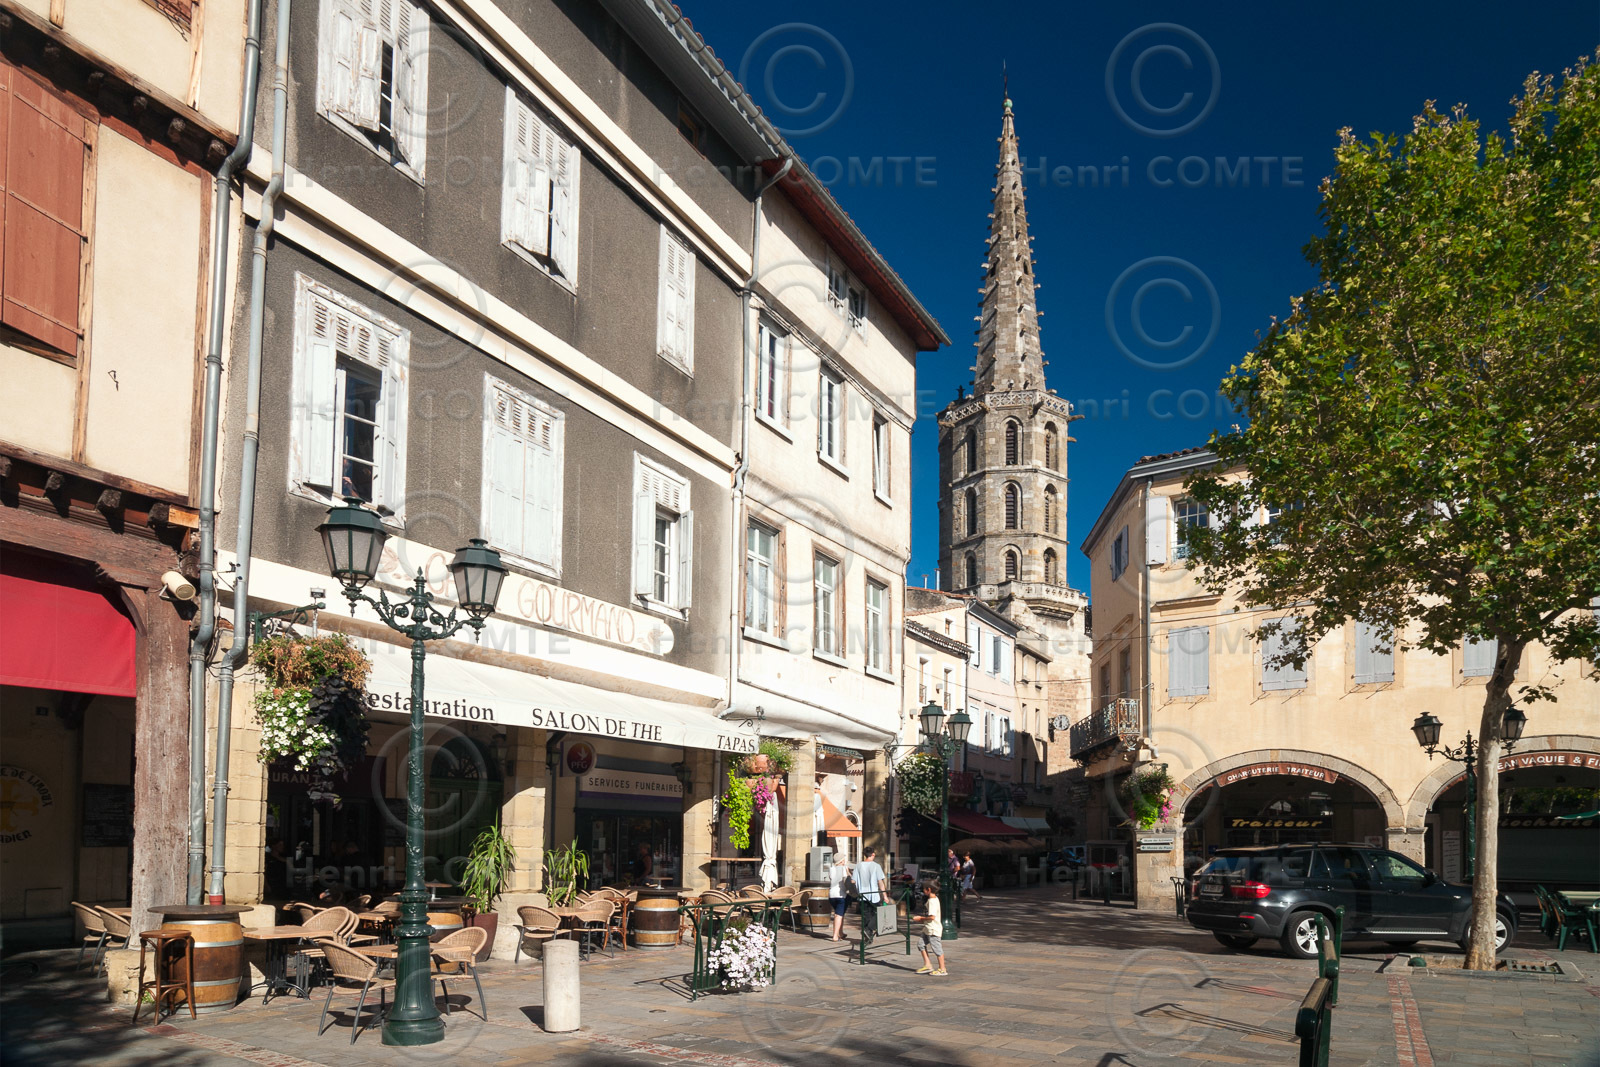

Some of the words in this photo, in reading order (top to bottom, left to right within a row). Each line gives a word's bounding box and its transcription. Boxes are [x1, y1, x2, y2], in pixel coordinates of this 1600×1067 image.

[518, 580, 635, 645] GOURMAND
[367, 692, 496, 722] estaration
[532, 708, 600, 733] SALON
[606, 718, 626, 737] DE
[632, 722, 662, 741] THE
[717, 734, 755, 752] TAPAS
[571, 761, 587, 769] PFG
[1497, 759, 1518, 770] EAN
[1521, 755, 1565, 765] VAQUIE
[1573, 756, 1581, 764] &
[1588, 758, 1600, 767] FI
[271, 771, 322, 784] URANT
[1227, 766, 1279, 782] CHARCUTERIE
[1287, 767, 1325, 779] TRAITEUR
[589, 777, 630, 789] SERVICES
[635, 780, 683, 793] FUNÉRAIRES
[1232, 818, 1323, 828] Traiteur
